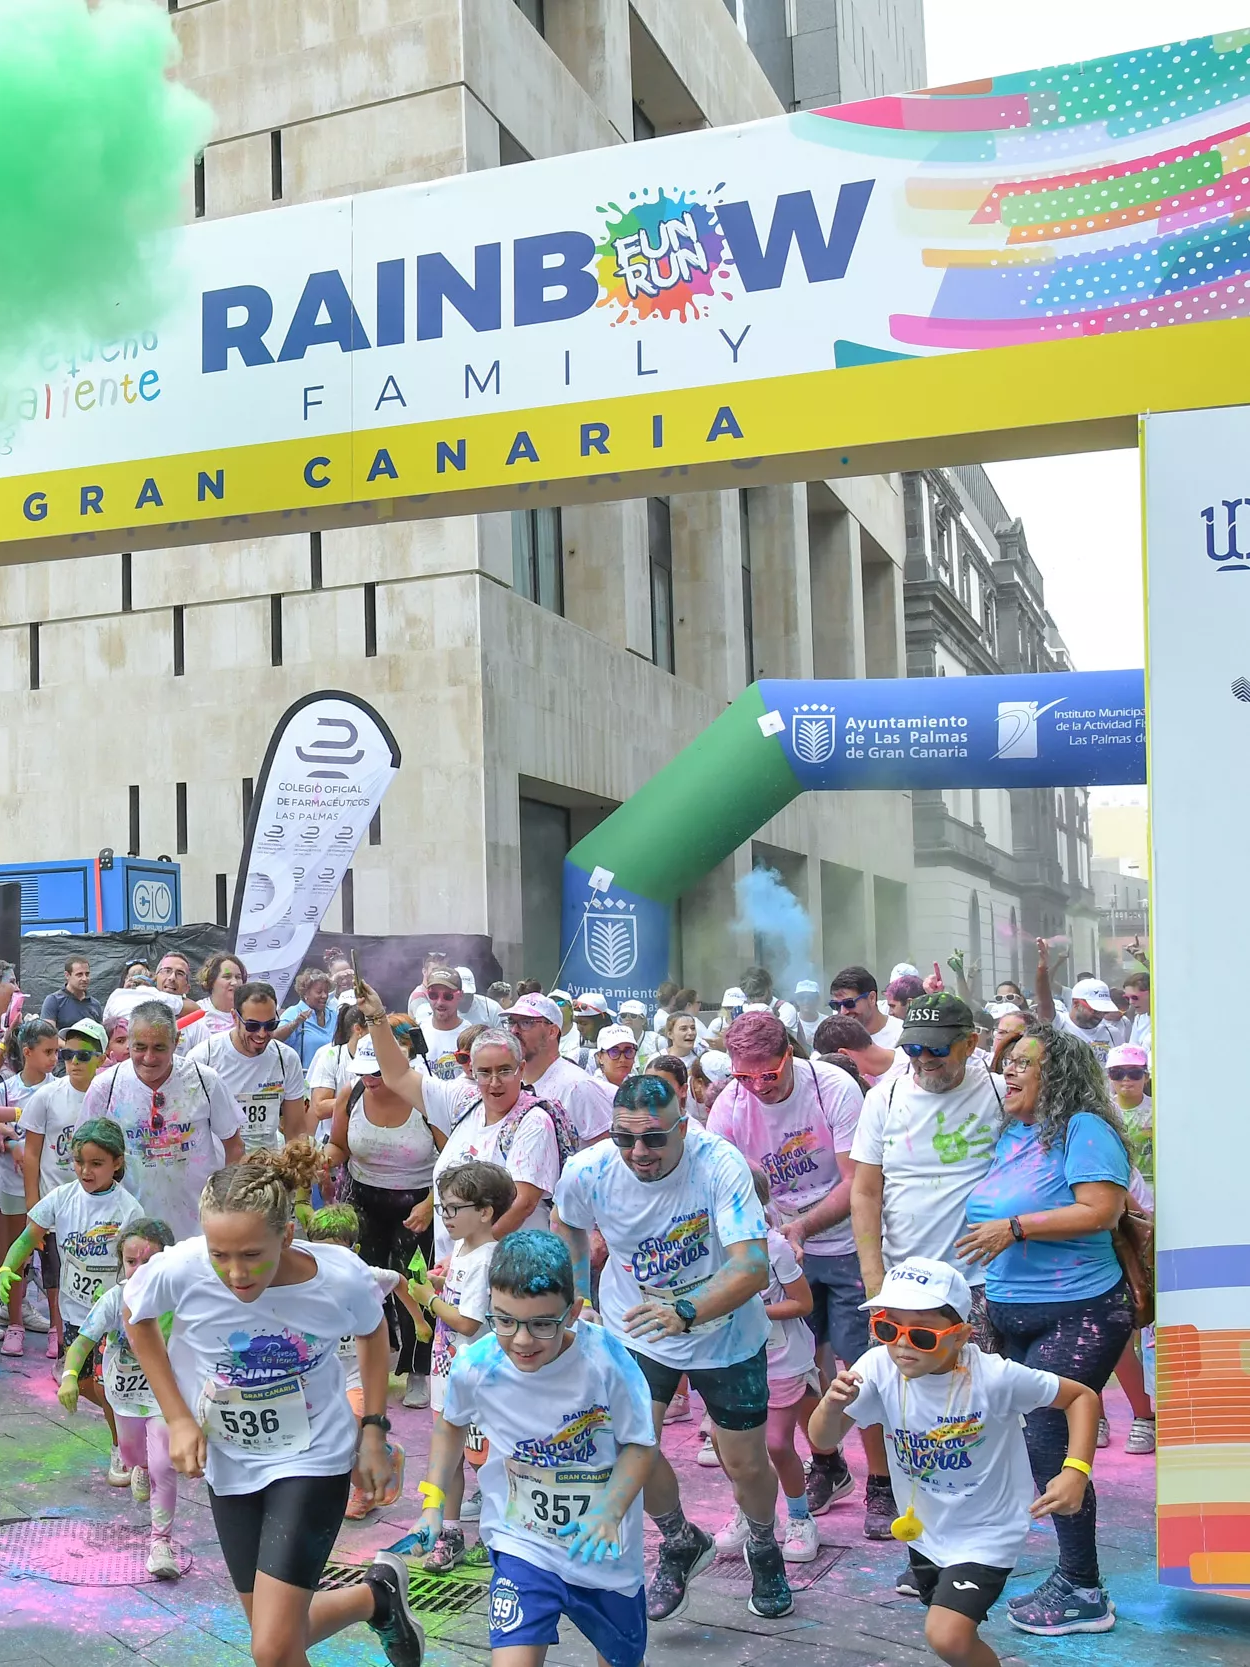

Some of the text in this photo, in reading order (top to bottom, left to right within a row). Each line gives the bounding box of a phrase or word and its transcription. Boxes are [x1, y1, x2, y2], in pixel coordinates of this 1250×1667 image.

[613, 211, 698, 268] FUN
[613, 241, 709, 299] RUN
[303, 324, 752, 421] FAMILY
[17, 369, 161, 421] aliente
[23, 405, 744, 521] GRAN CANARIA
[1054, 709, 1096, 719] Instituto
[845, 715, 968, 732] Ayuntamiento
[1055, 722, 1070, 731] de
[1072, 721, 1081, 731] la
[1083, 720, 1132, 730] Actividad
[845, 730, 968, 744] de Las Palmas
[1069, 735, 1088, 746] Las
[1091, 734, 1131, 744] Palmas
[845, 745, 968, 759] de Gran Canaria
[278, 782, 363, 794] COLEGIO OFICIAL
[277, 797, 290, 806] DE
[275, 811, 340, 821] LAS PALMAS
[631, 1241, 710, 1282] Colores
[115, 1374, 149, 1392] 322
[243, 1384, 296, 1400] GRAN CANARIA
[220, 1408, 280, 1437] 536
[531, 1489, 591, 1526] 357
[493, 1597, 512, 1618] 99
